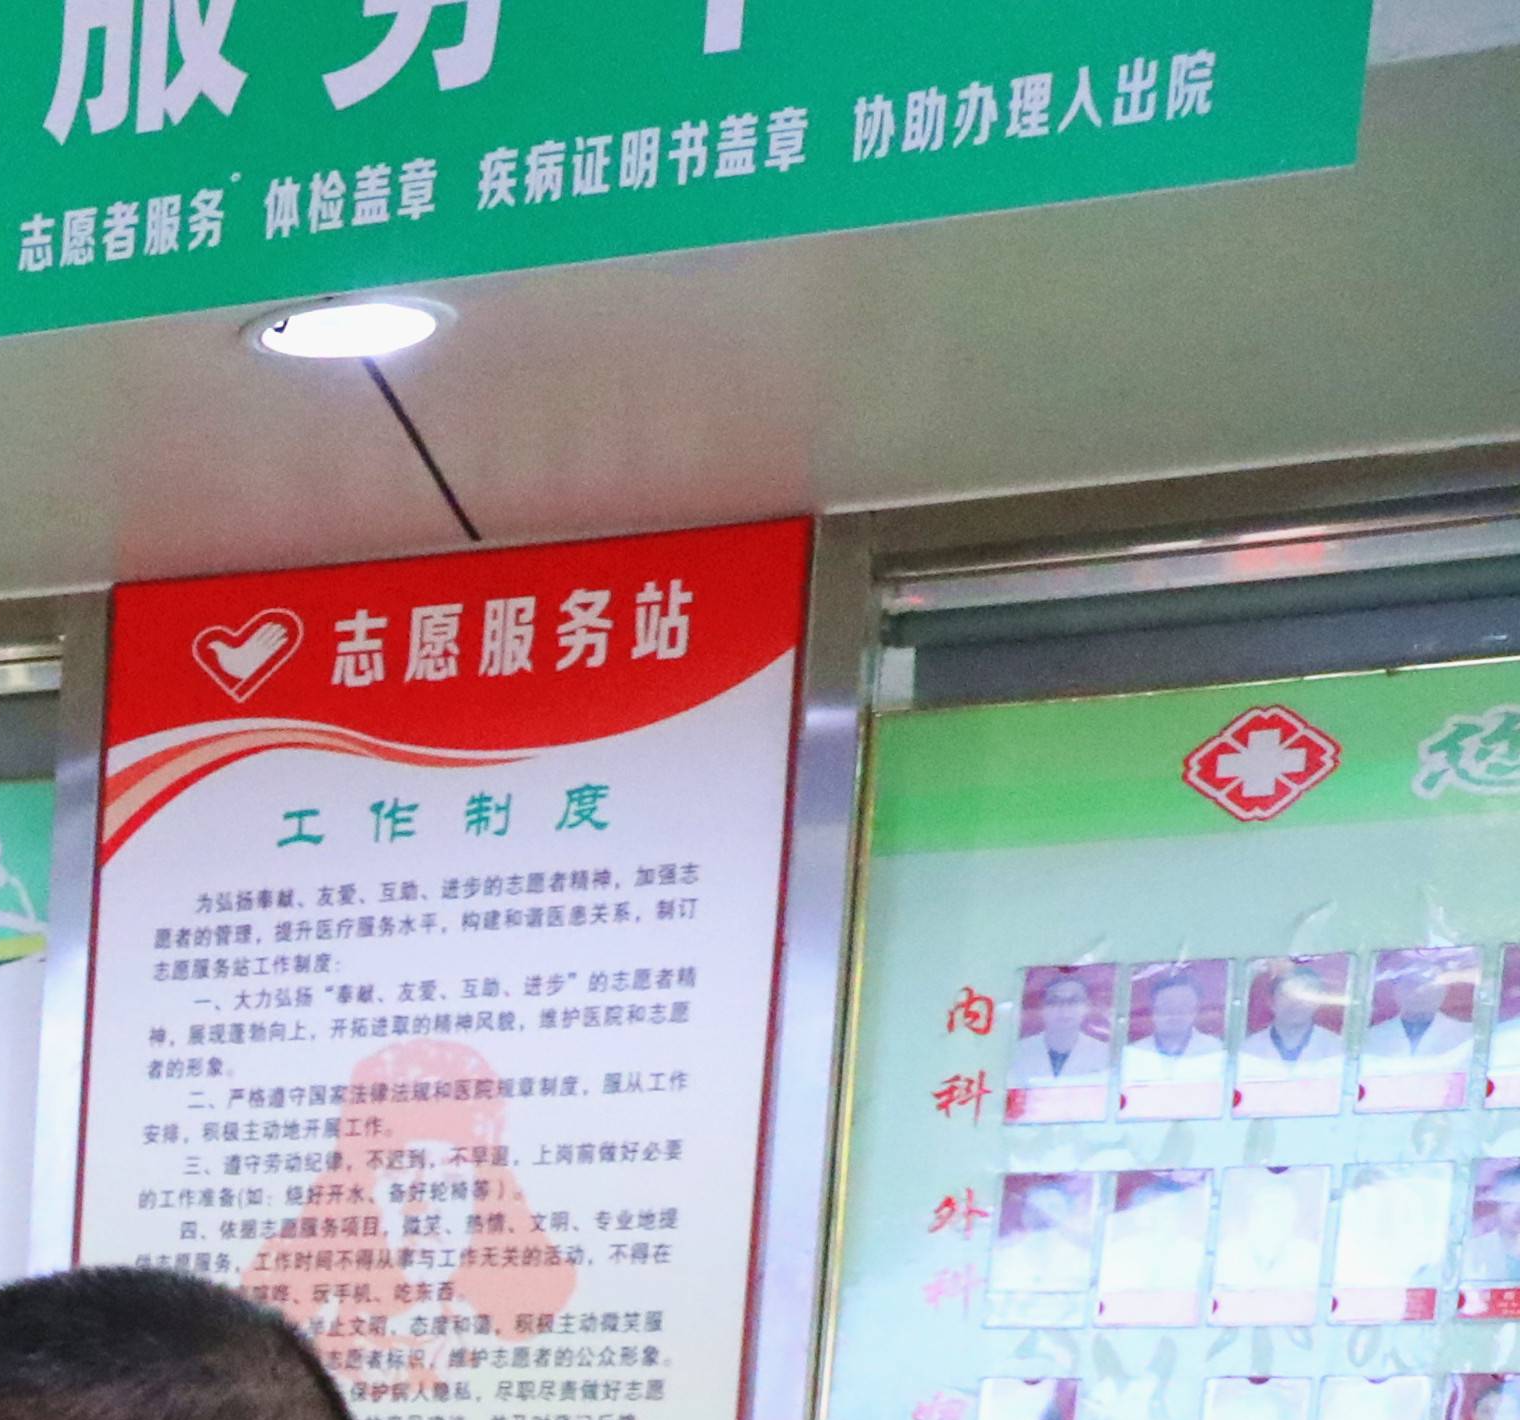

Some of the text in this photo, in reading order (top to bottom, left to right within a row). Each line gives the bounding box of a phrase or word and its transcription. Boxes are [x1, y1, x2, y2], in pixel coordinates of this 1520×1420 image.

[18, 187, 226, 273] 志愿者服务
[263, 156, 440, 241] 体检盖章
[476, 105, 811, 211] 疾病证明书盖章
[330, 578, 696, 687] 志愿服务站
[275, 782, 611, 849] 工作制度
[932, 985, 996, 1125] 内科
